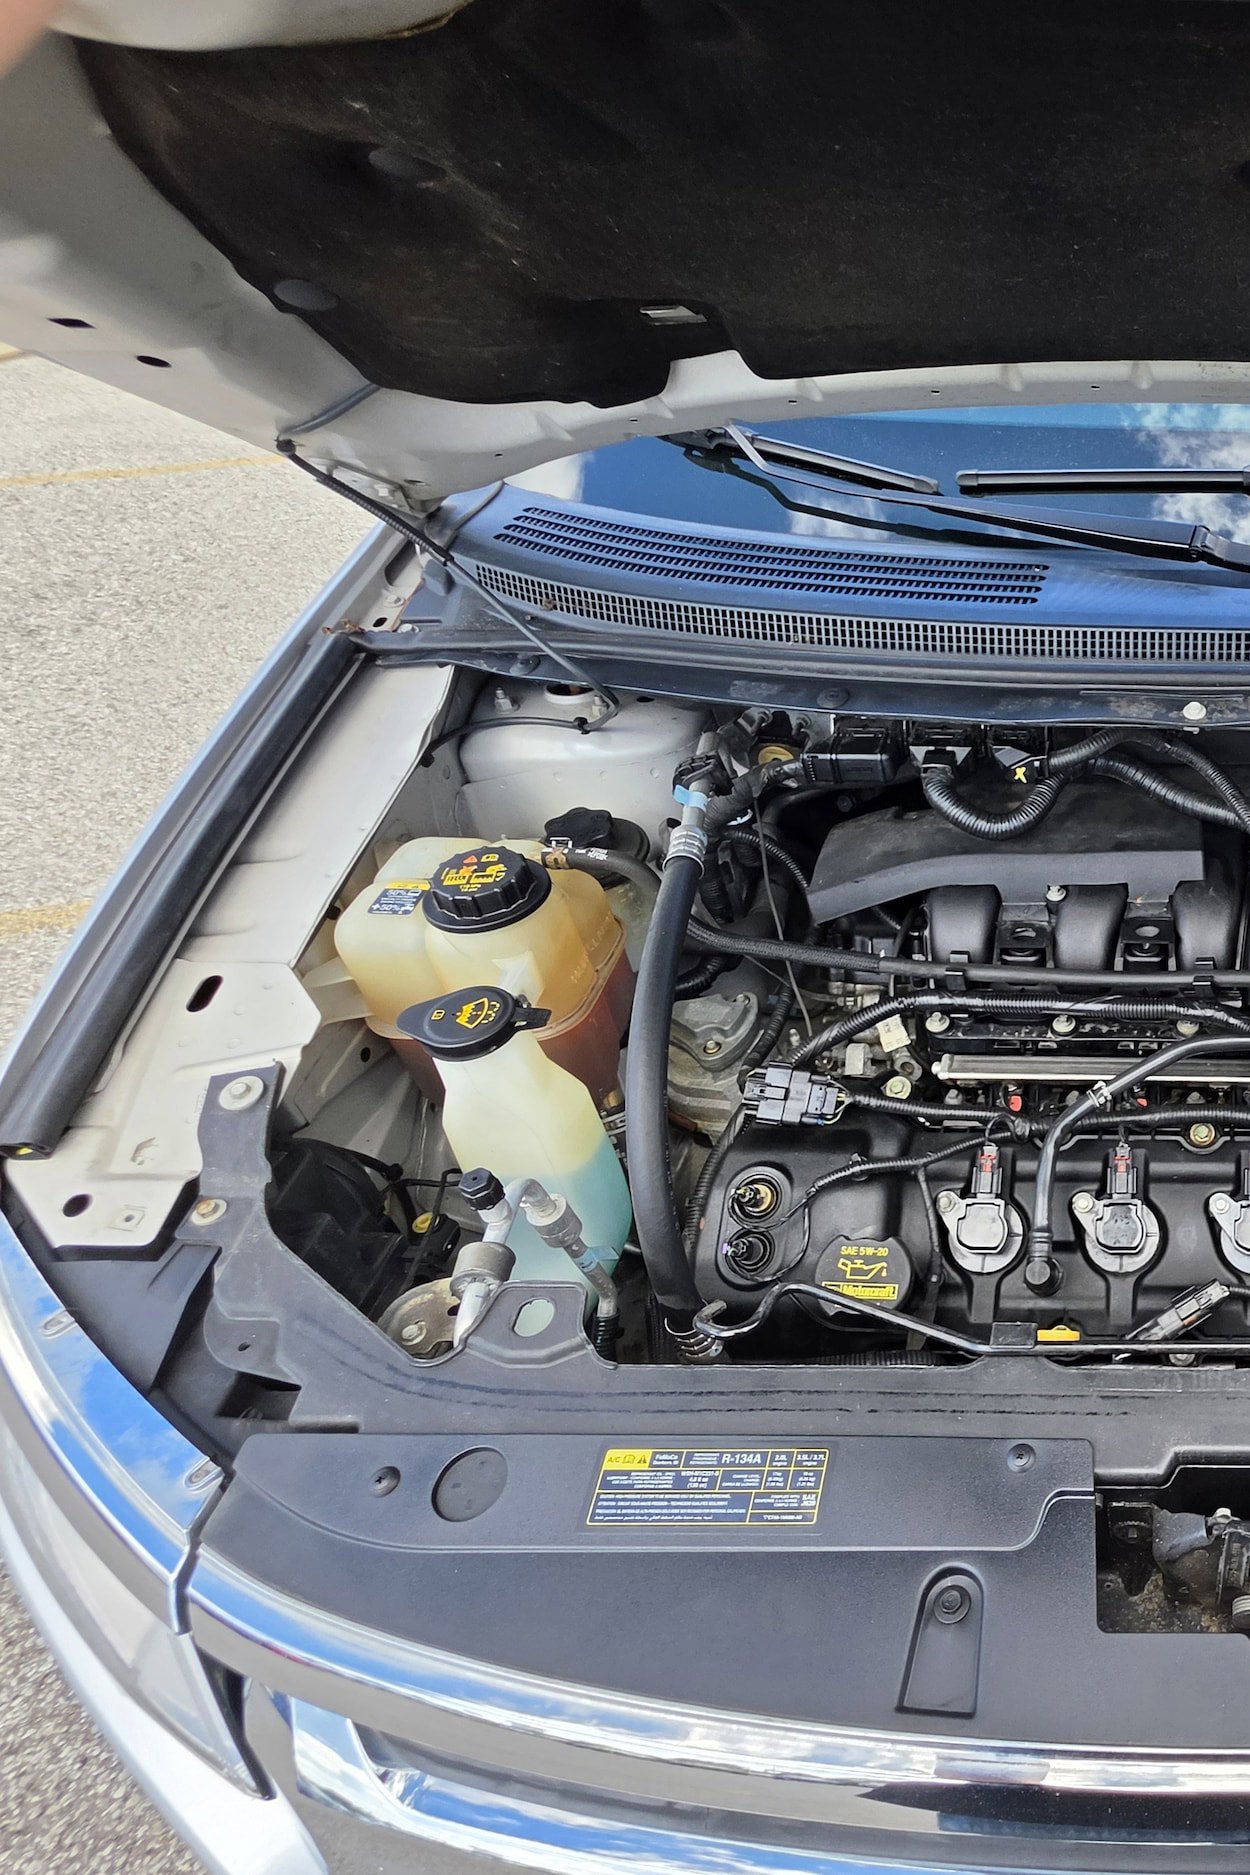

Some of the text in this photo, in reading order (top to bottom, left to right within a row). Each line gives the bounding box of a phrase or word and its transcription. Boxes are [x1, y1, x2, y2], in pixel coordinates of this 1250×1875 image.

[840, 1246, 889, 1257] SAE 5W-20
[843, 1284, 894, 1297] Motorcraft
[721, 1453, 762, 1464] R-134A
